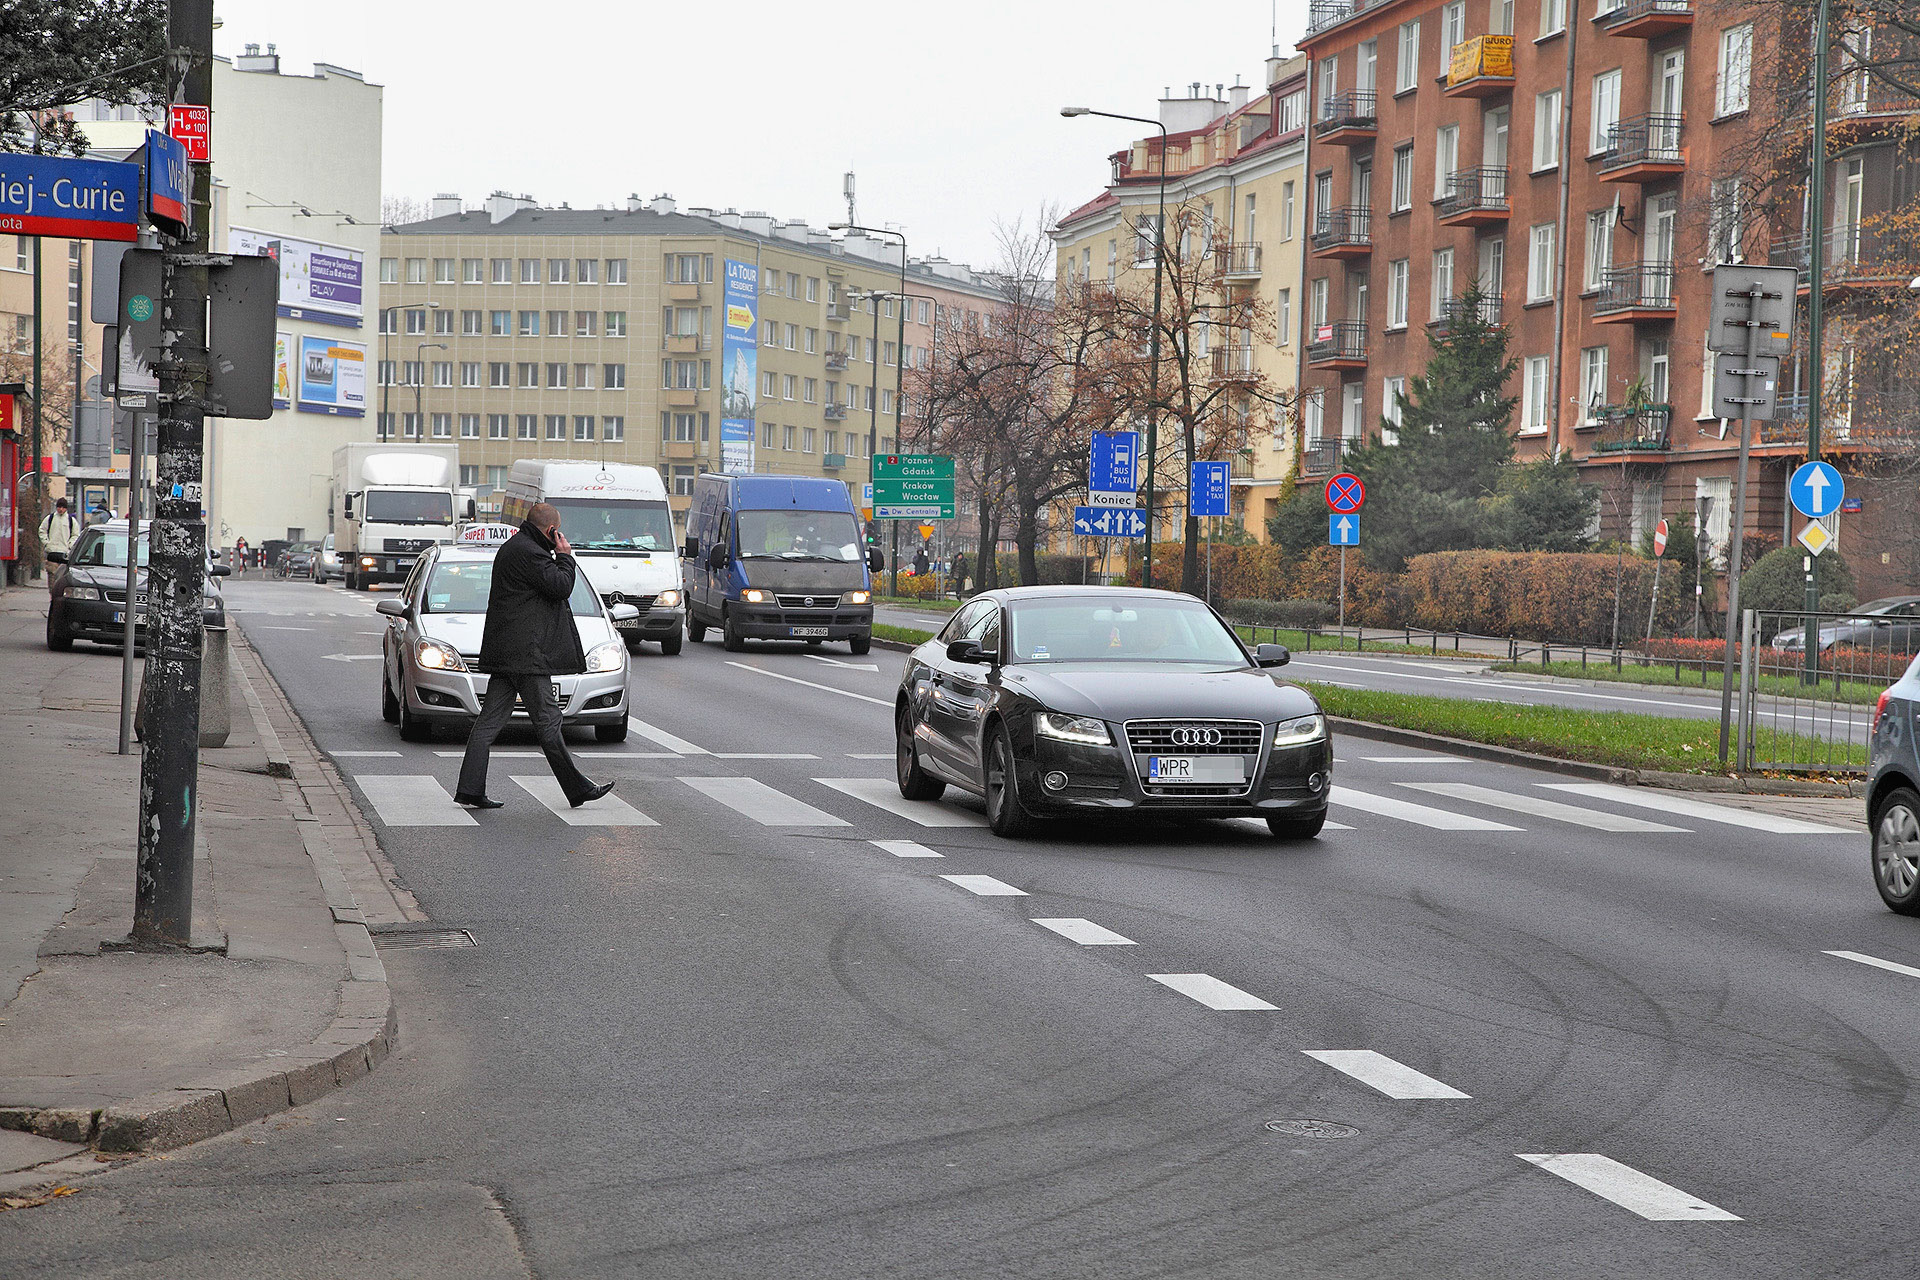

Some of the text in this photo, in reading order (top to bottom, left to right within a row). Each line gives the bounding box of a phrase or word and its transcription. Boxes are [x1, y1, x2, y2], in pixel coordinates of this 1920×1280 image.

[1485, 37, 1512, 45] BIURO
[188, 110, 206, 120] 4032
[171, 112, 184, 129] H
[193, 123, 206, 133] 100
[728, 262, 757, 282] LA TOUR
[311, 284, 335, 297] PLAY
[730, 280, 753, 292] RESIDENCE
[729, 309, 750, 323] 5 minut
[902, 455, 933, 464] Poznań
[902, 467, 935, 475] Gdańsk
[1113, 467, 1129, 475] BUS
[1112, 476, 1130, 485] TAXI
[902, 481, 935, 490] Kraków
[1210, 485, 1223, 493] BUS
[902, 492, 940, 501] Wrocław
[1093, 494, 1132, 505] Koniec
[1210, 492, 1224, 500] TAXI
[905, 508, 939, 516] Centralny
[464, 528, 486, 541] SUPER
[488, 527, 508, 540] TAXI
[1159, 759, 1190, 776] WPR
